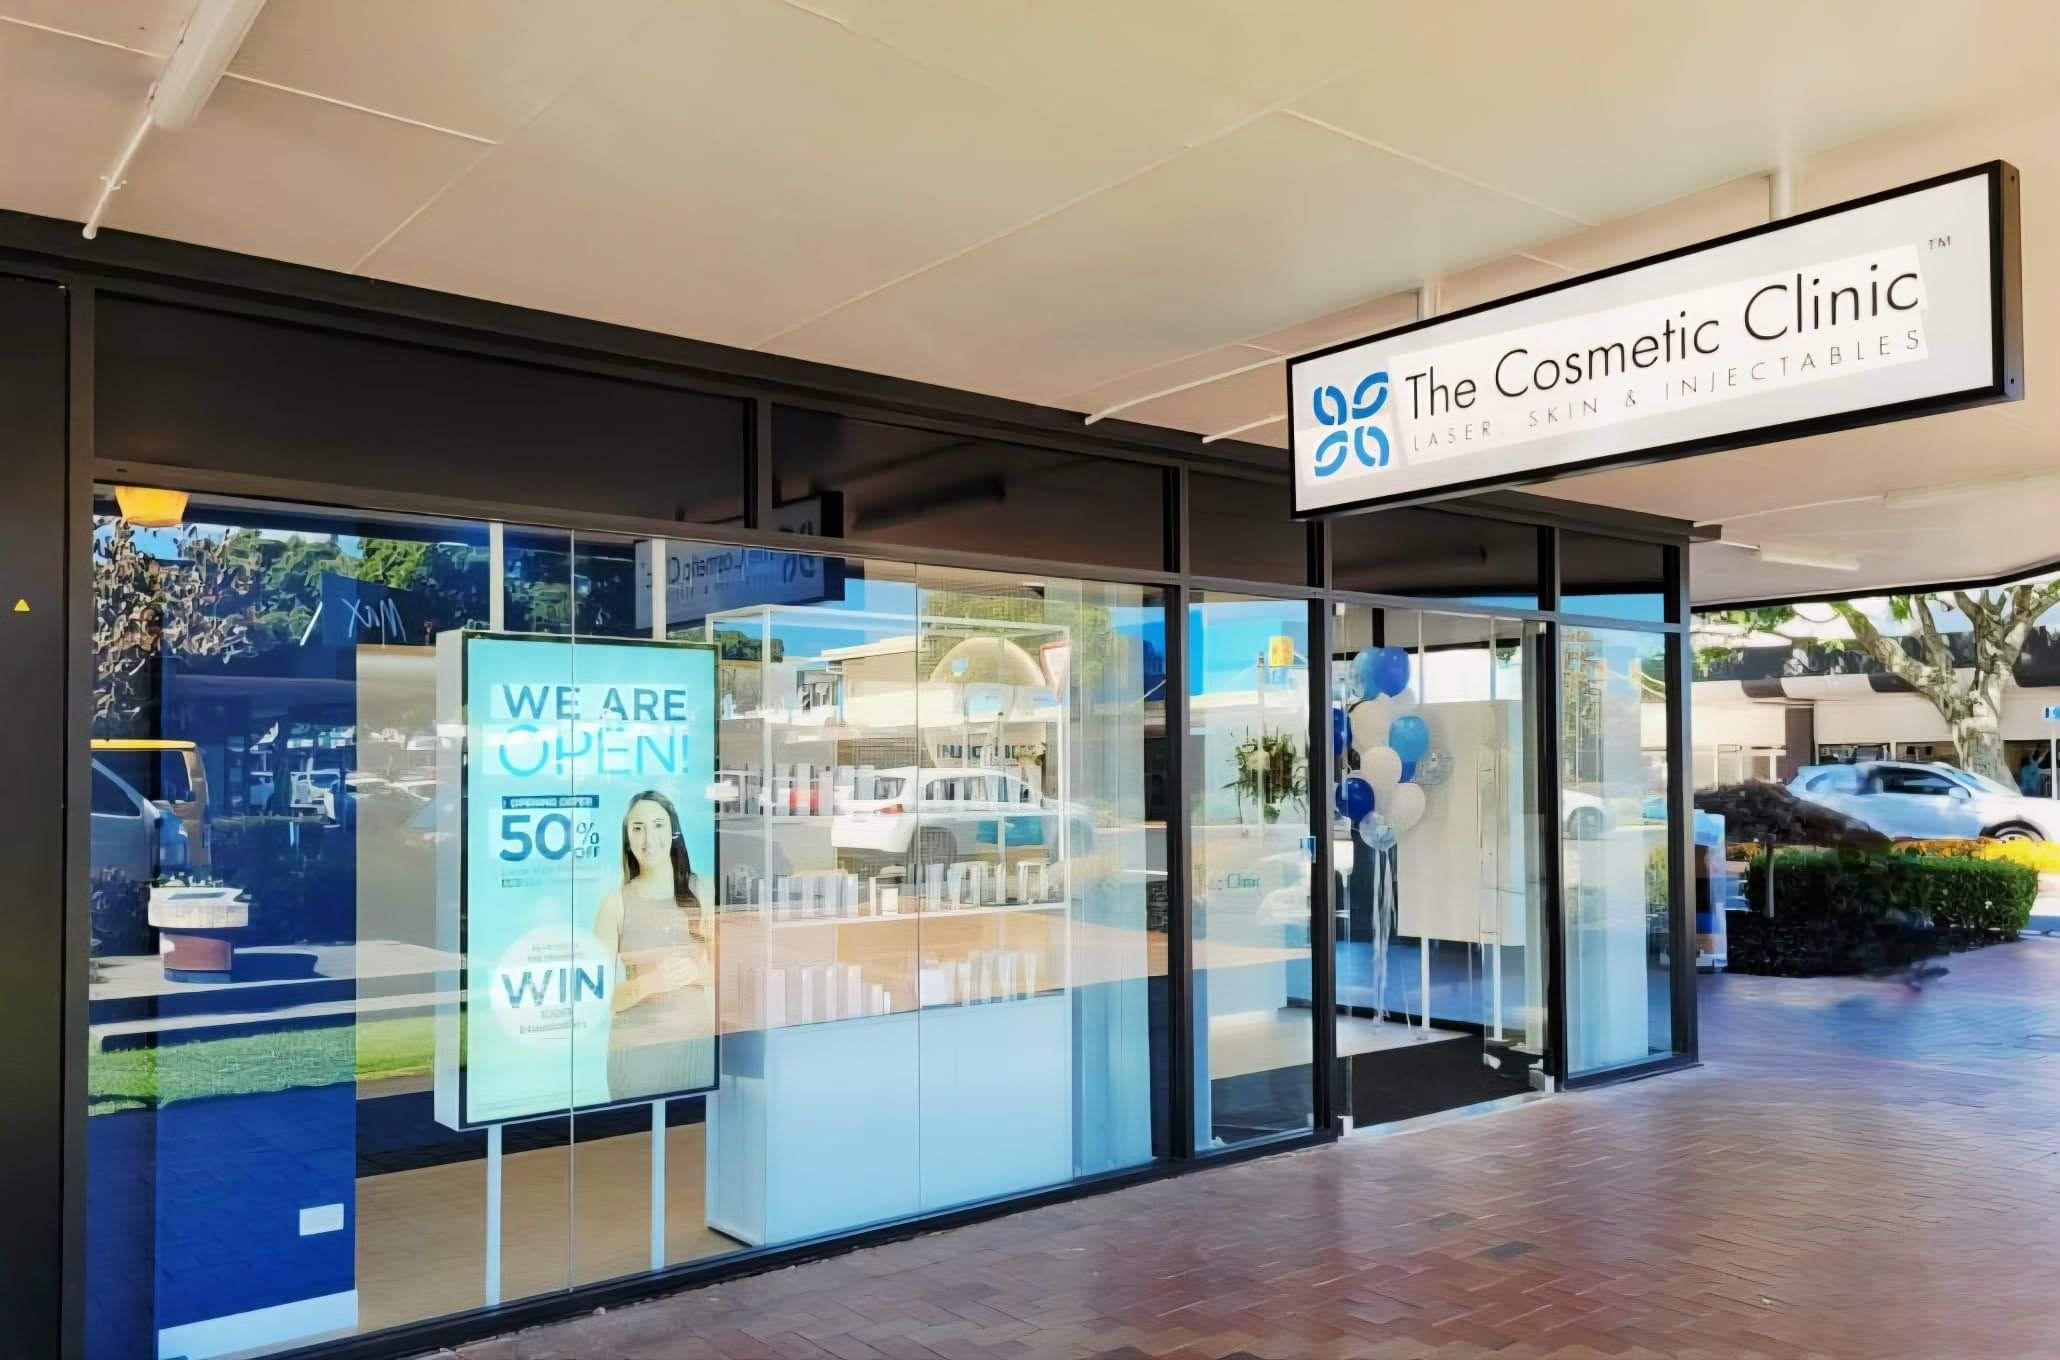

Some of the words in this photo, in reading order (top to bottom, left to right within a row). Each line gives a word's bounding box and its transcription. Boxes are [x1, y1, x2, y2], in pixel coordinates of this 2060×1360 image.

[1404, 365, 1477, 420] The
[1494, 310, 1720, 398] Cosmetic
[1743, 263, 1919, 341] Clinic
[1528, 397, 1598, 428] SKIN
[1624, 388, 1637, 408] &
[1664, 329, 1920, 401] INJECTABLES
[502, 684, 581, 720] WE
[600, 688, 687, 721] ARE
[499, 725, 689, 777] OPEN!
[501, 964, 605, 1008] WIN
